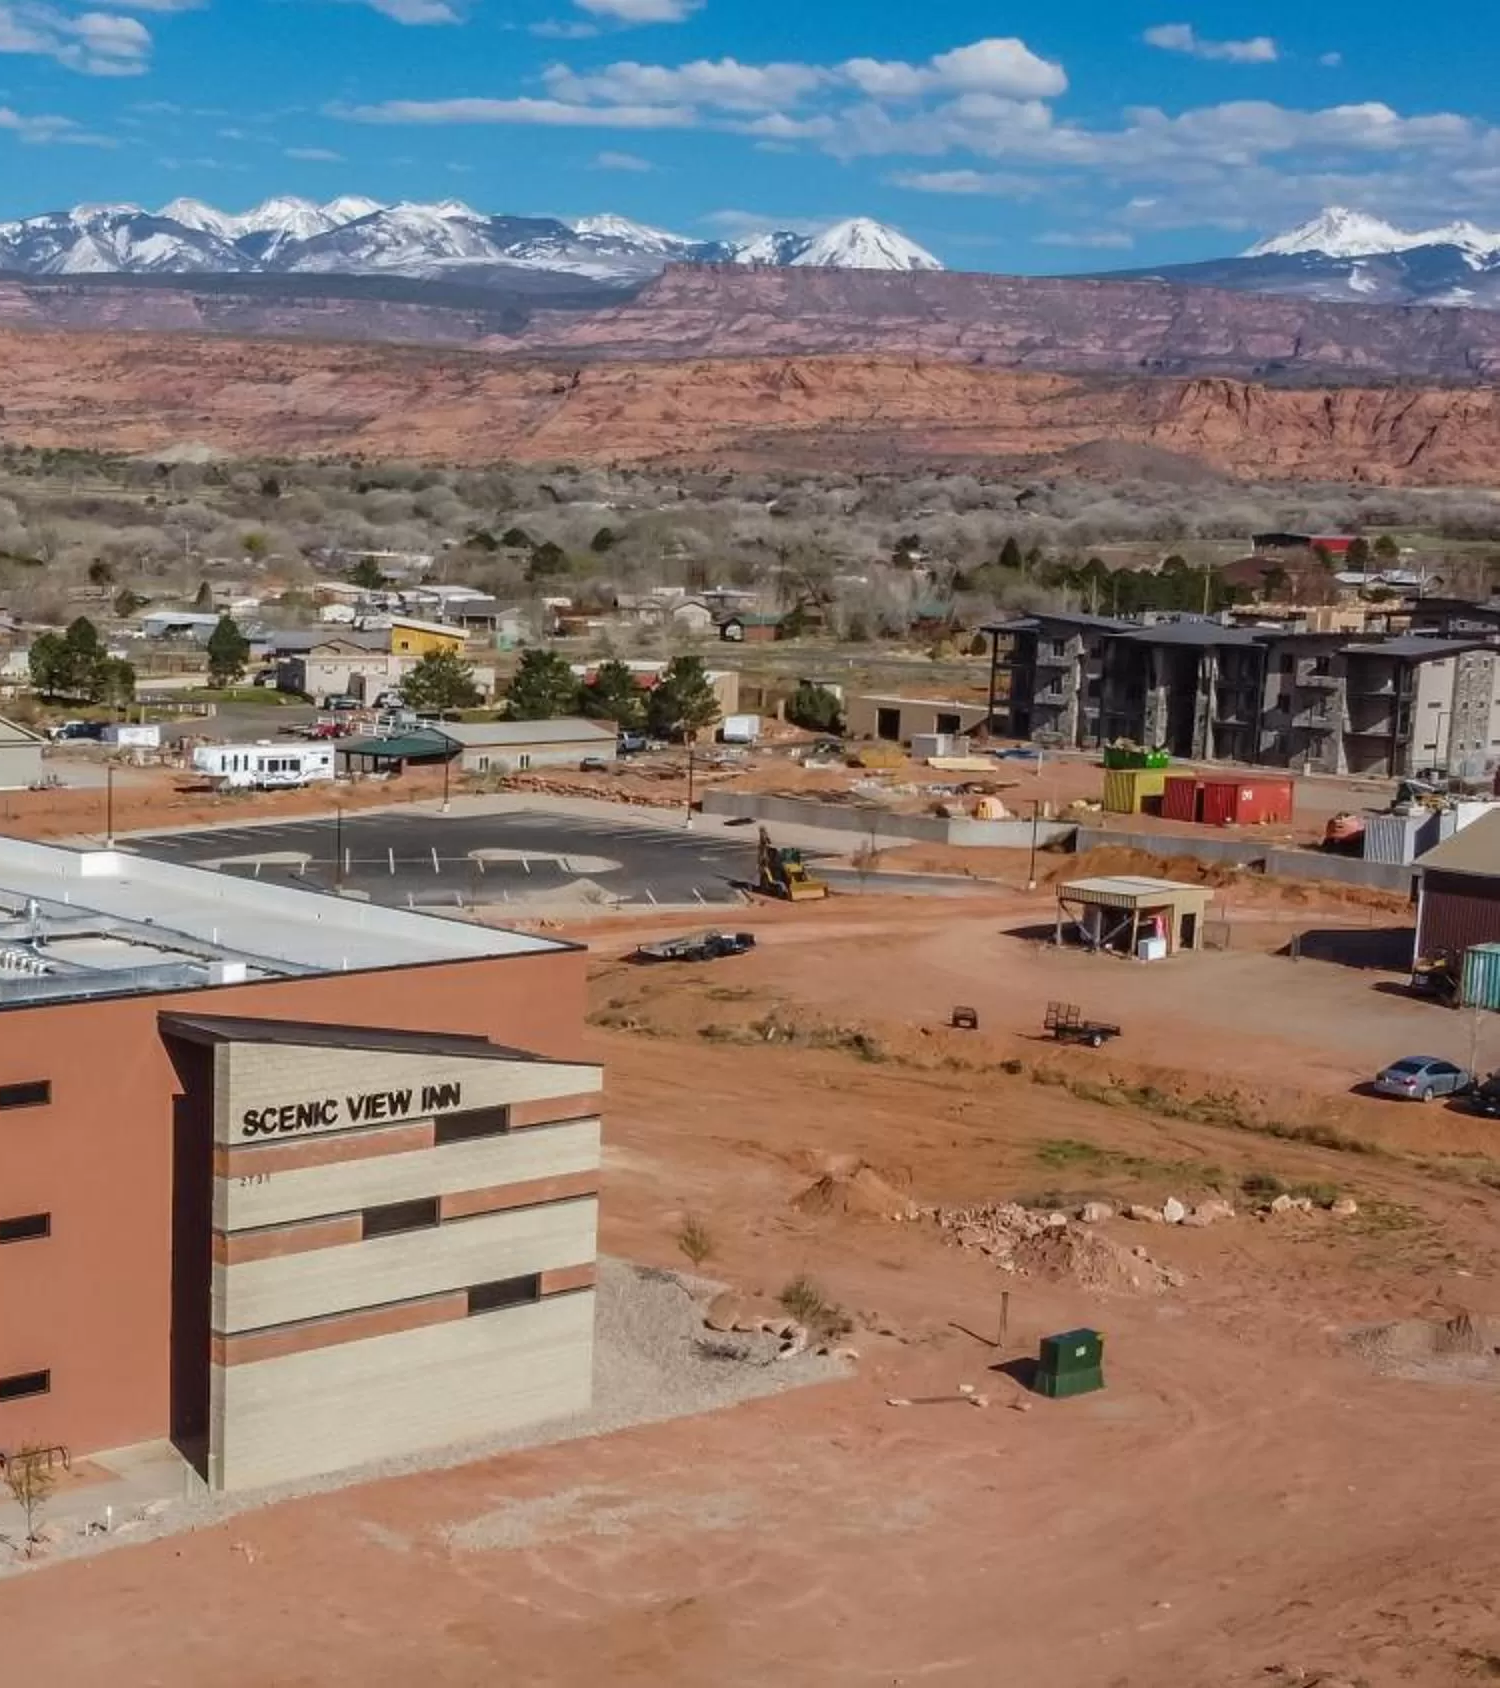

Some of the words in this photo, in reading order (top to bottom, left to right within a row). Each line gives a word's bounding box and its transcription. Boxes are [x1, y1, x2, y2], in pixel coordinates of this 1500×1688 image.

[242, 1101, 338, 1137] SCENIC
[346, 1089, 412, 1121] VIEW
[421, 1081, 461, 1111] INN
